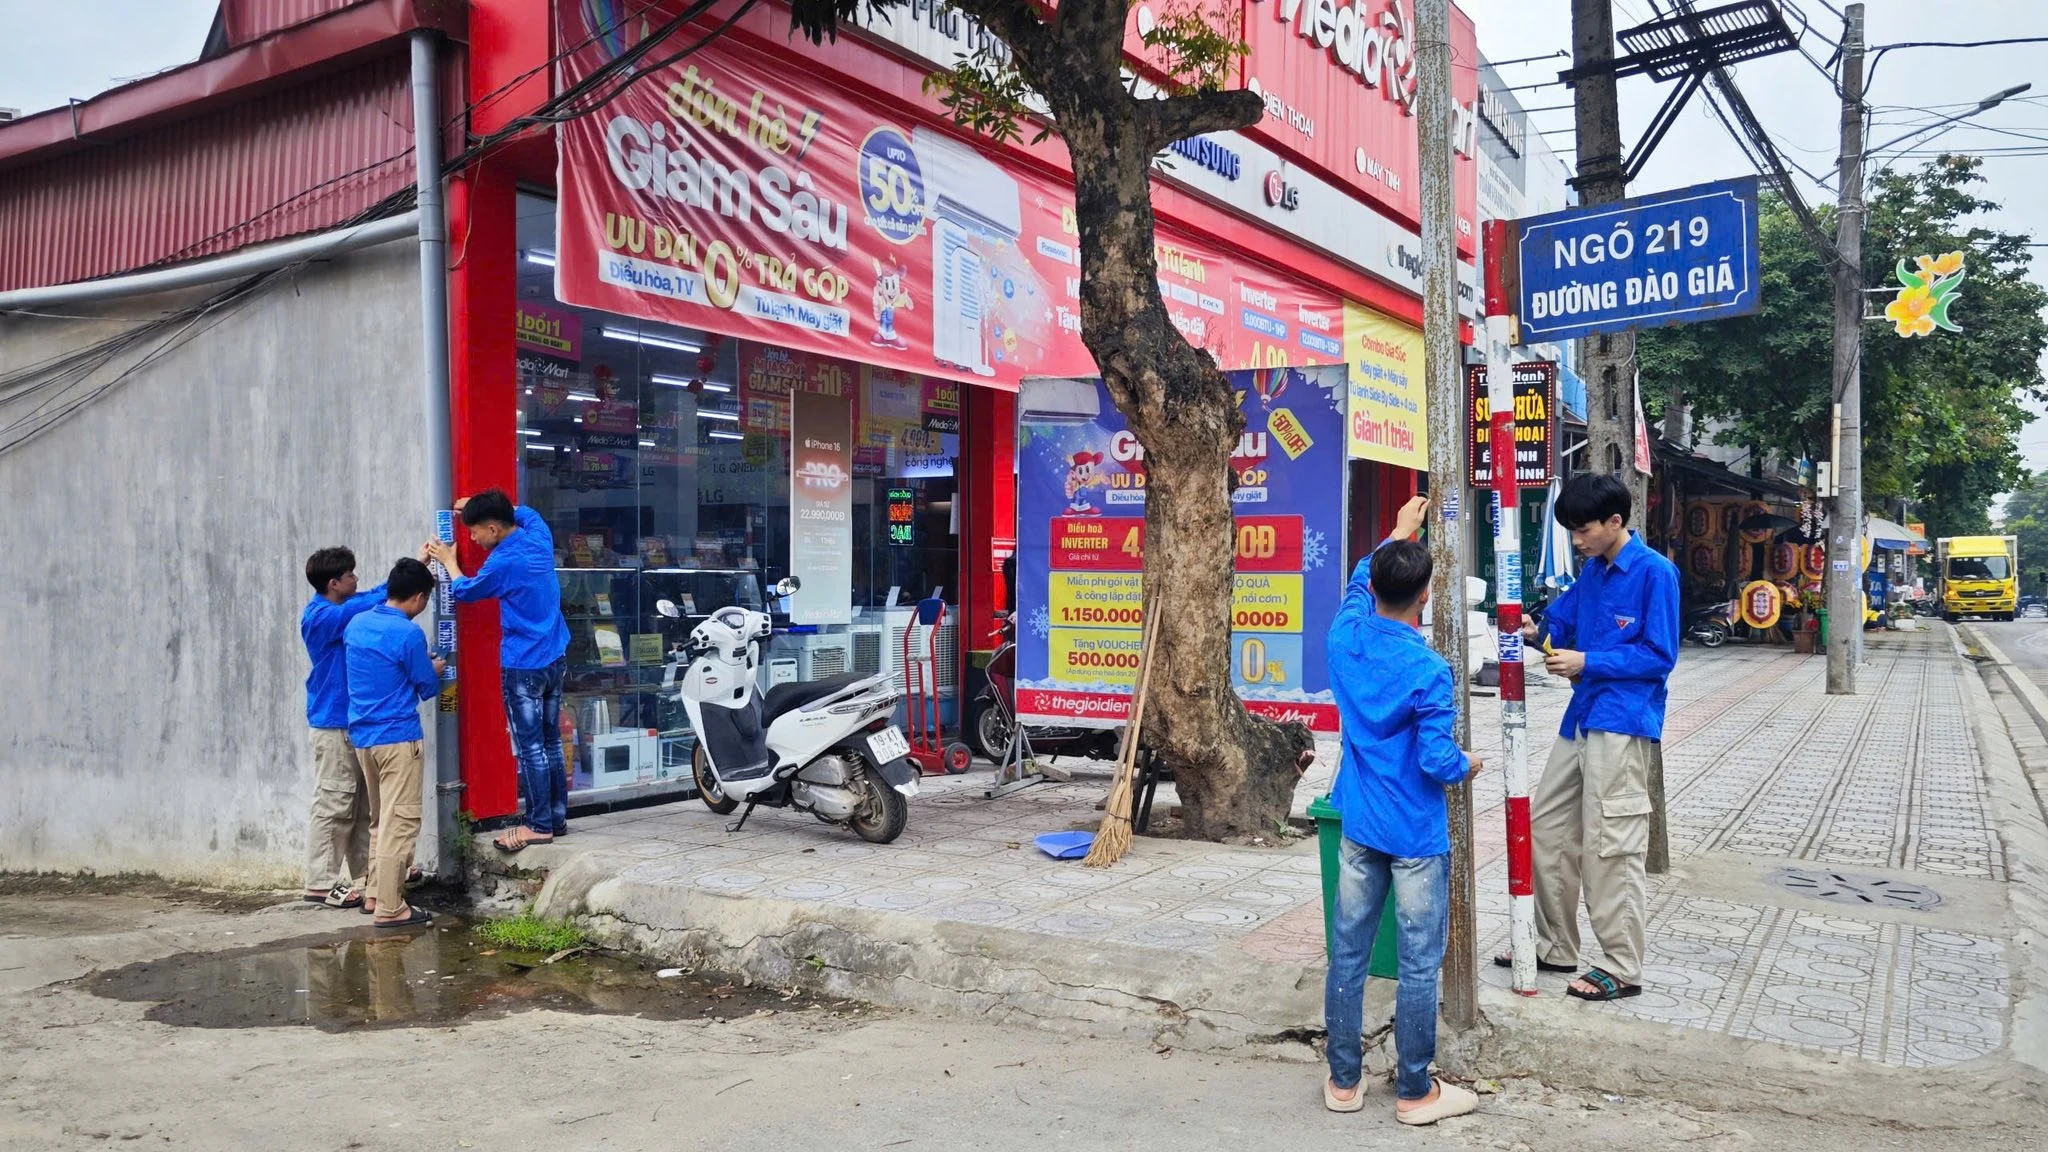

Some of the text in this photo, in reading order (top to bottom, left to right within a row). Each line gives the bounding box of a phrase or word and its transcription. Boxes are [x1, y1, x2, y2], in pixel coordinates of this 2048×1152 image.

[749, 90, 792, 155] hè
[1263, 90, 1314, 141] ĐIỆN THOẠI
[1482, 83, 1524, 158] SAMSUNG
[1168, 134, 1240, 181] AMSUNG
[1367, 156, 1383, 182] MÁY
[606, 114, 848, 251] Giảm Sâu
[1280, 182, 1299, 211] LG
[1554, 216, 1709, 269] NGÕ 219
[609, 260, 643, 284] Điều
[675, 276, 694, 297] TV
[754, 253, 798, 293] TRẢ
[803, 265, 850, 304] GÓP
[1532, 254, 1735, 319] ĐƯỜNG ĐÀO GIÃ
[1240, 281, 1277, 313] Inverter
[799, 306, 823, 328] Máy
[1299, 304, 1330, 332] Inverter
[1362, 334, 1384, 355] Combo
[1513, 371, 1545, 385] Hạnh
[1353, 410, 1414, 453] Giảm 1 triệu
[1514, 426, 1545, 444] HOẠI
[811, 440, 841, 452] iPhone 16
[1110, 430, 1144, 462] Gi
[643, 467, 655, 476] LG
[905, 456, 928, 469] công
[805, 462, 840, 487] PRO
[706, 488, 724, 503] LG
[1062, 537, 1108, 549] INVERTER
[1069, 553, 1080, 561] Giá
[1067, 574, 1089, 586] Miễn
[1085, 590, 1107, 602] công
[1062, 606, 1289, 627] 1.150.000 .000Đ
[1073, 638, 1095, 651] Tặng
[1068, 651, 1139, 668] 500.000
[1052, 695, 1131, 714] thegioidien
